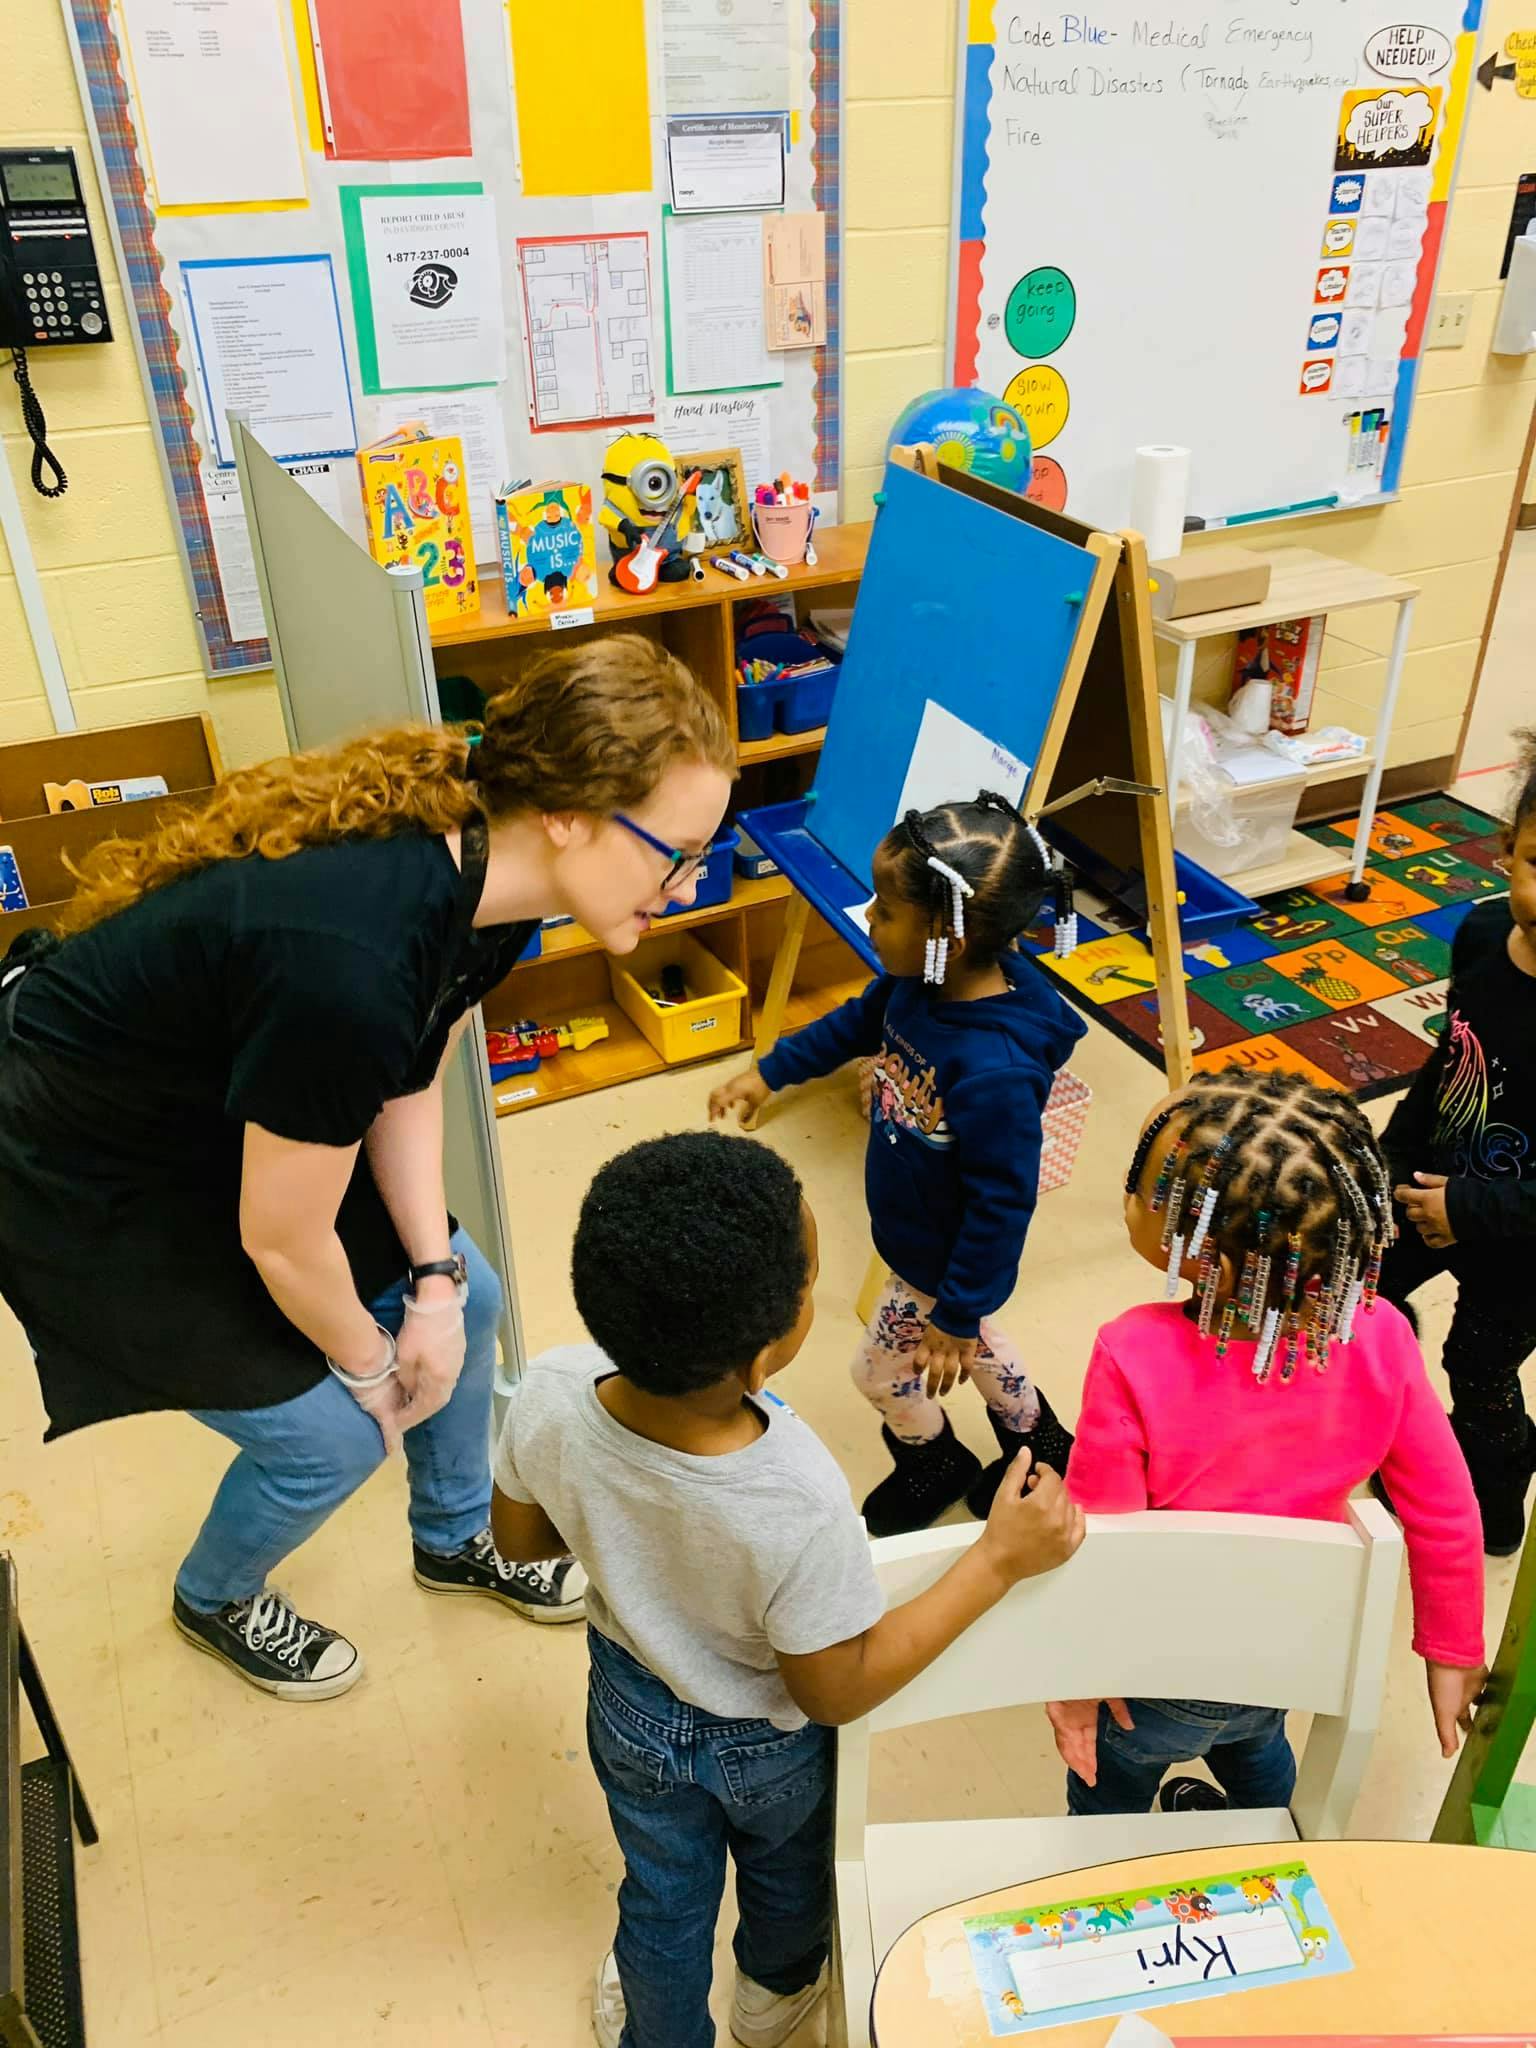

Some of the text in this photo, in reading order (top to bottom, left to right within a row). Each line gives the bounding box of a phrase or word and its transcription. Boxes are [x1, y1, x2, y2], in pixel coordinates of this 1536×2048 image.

[1008, 15, 1056, 47] Code
[1132, 19, 1209, 49] Medical
[1225, 18, 1313, 63] Emergency
[1389, 28, 1424, 46] HELP
[1376, 48, 1436, 66] NEEDED!!
[1003, 63, 1079, 96] Natural
[1087, 66, 1163, 96] Disasters
[682, 122, 769, 132] Certificate of Membership
[1364, 109, 1402, 128] SUPER
[1006, 118, 1042, 146] Fire
[1357, 125, 1409, 146] HELPERS
[380, 211, 465, 224] REPORT CHILD ABUSE
[386, 247, 470, 264] 1-877-237-0004
[1026, 278, 1065, 299] keep
[1015, 304, 1055, 324] going
[1017, 379, 1051, 396] Slow
[673, 400, 754, 419] Hand Washing
[292, 465, 324, 475] CHART
[500, 530, 512, 569] MUSIC
[530, 530, 579, 554] MUSIC
[550, 553, 576, 569] IS...
[93, 787, 120, 800] Bob
[1375, 927, 1429, 945] Qq
[1302, 948, 1348, 969] Pp
[1330, 1014, 1379, 1034] Vv
[1226, 1045, 1280, 1068] Uu
[1136, 1924, 1238, 1983] Kyri
